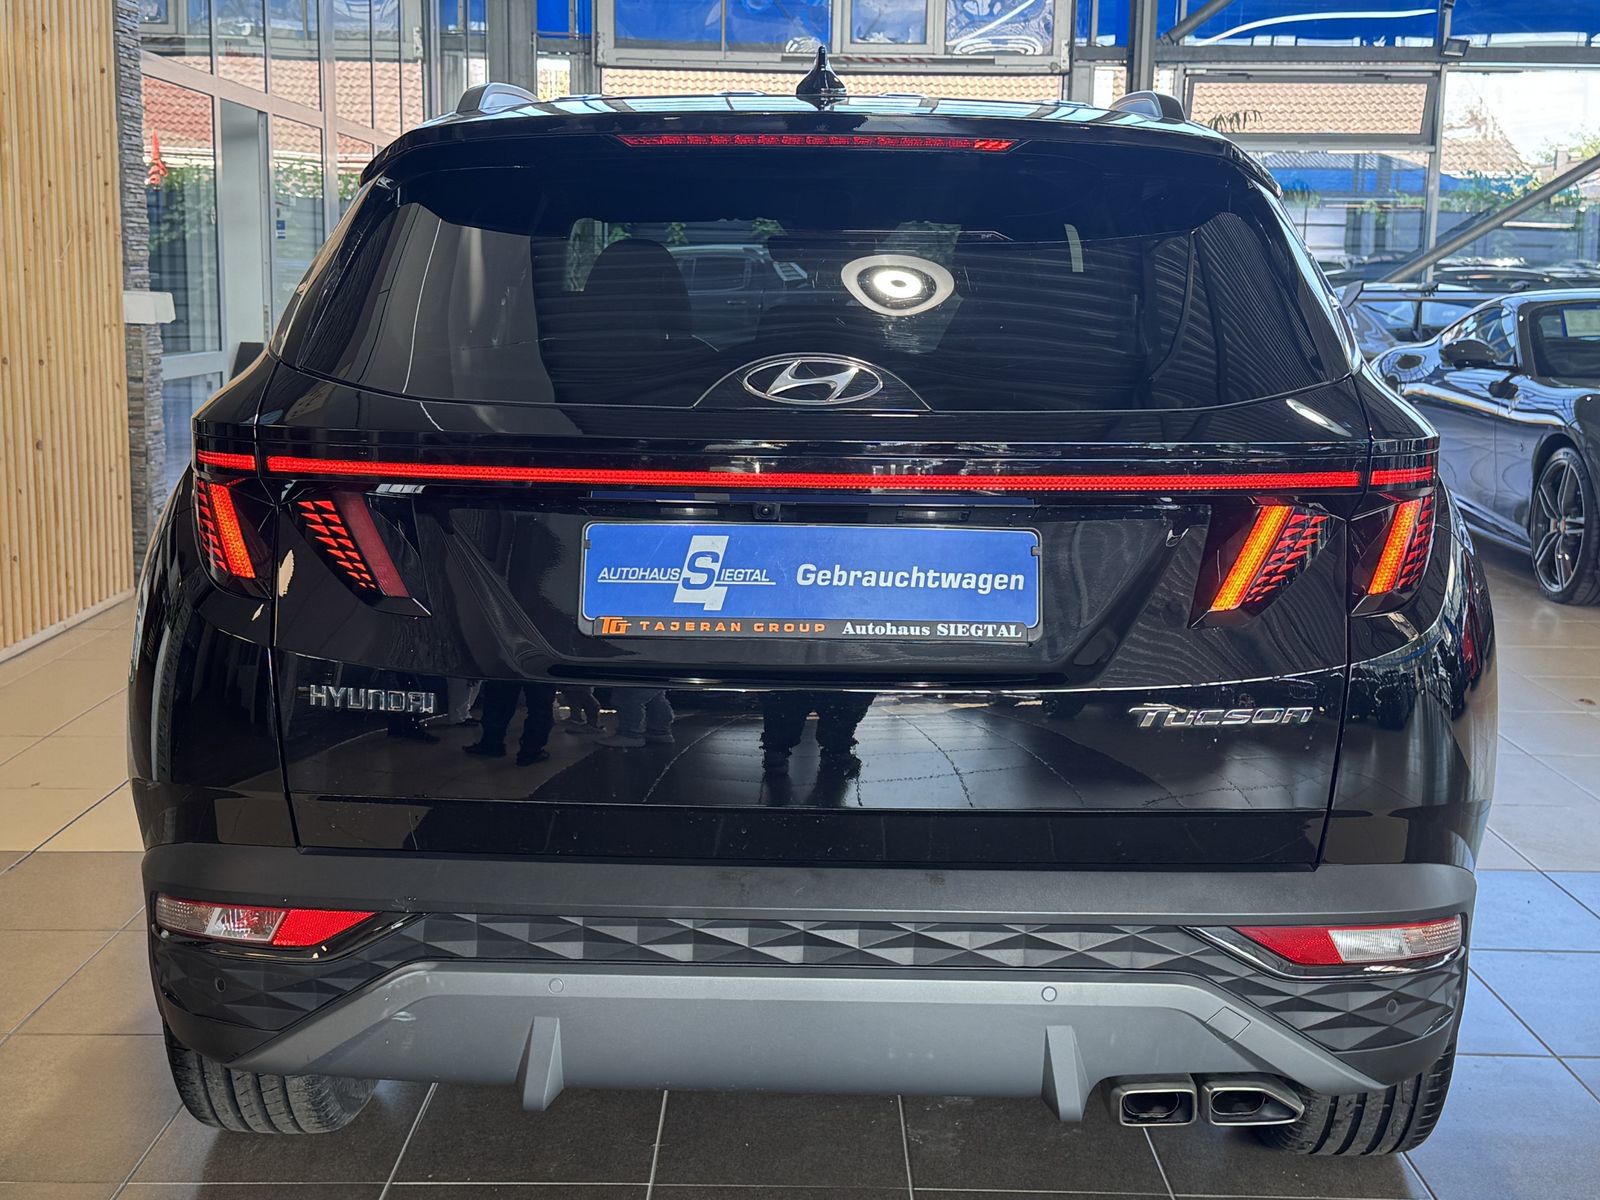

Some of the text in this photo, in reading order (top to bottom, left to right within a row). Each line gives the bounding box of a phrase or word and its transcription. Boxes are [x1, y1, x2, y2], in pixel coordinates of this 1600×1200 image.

[598, 567, 681, 581] AUTOHAUS
[796, 563, 1025, 595] Gebrauchtwagen
[639, 621, 742, 632] TAJERAN
[753, 623, 826, 634] GROUP
[842, 621, 1022, 638] Autohaus SIEGTAL
[309, 684, 435, 714] HYUNDAI
[1128, 706, 1314, 728] TUCSON
